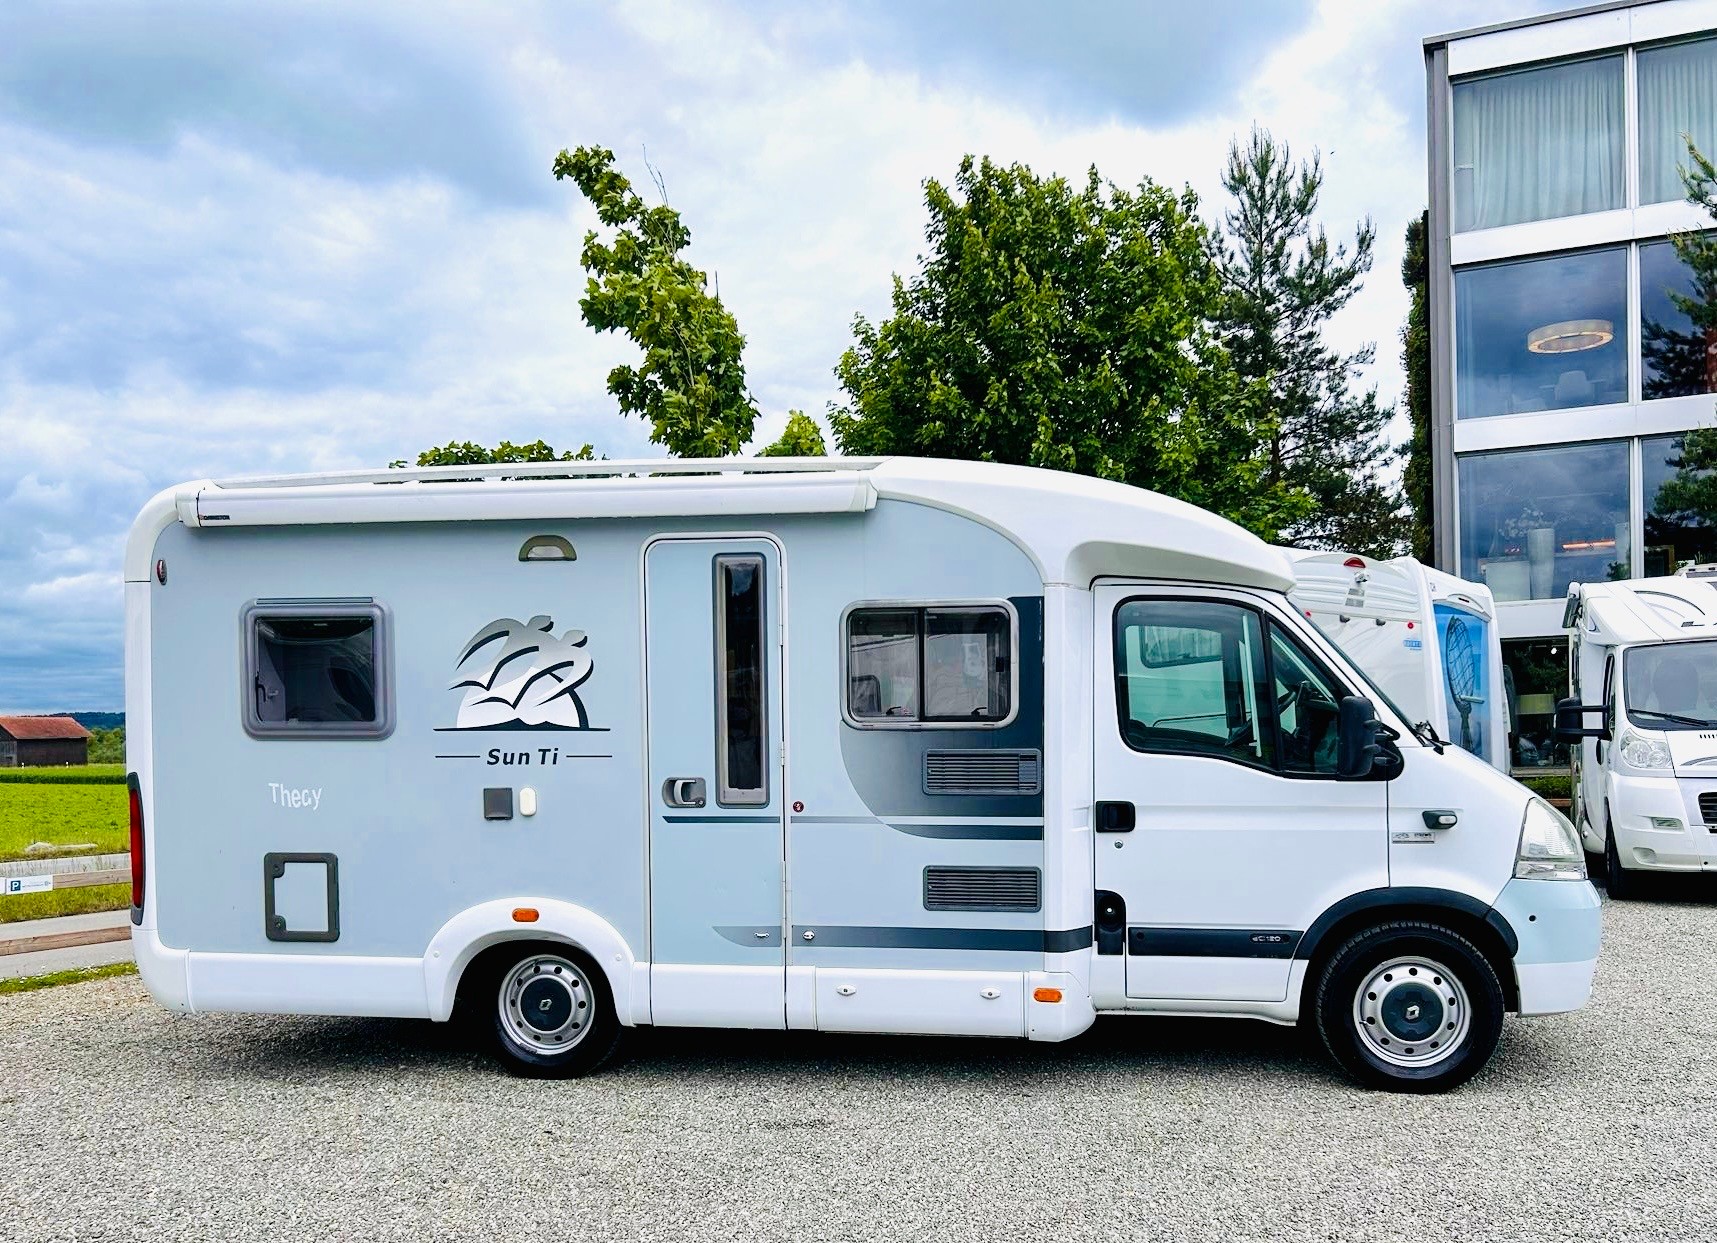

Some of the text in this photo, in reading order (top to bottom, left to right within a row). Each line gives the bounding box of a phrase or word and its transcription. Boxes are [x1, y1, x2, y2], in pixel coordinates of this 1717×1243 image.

[486, 747, 559, 766] Sun Ti
[11, 881, 20, 891] P
